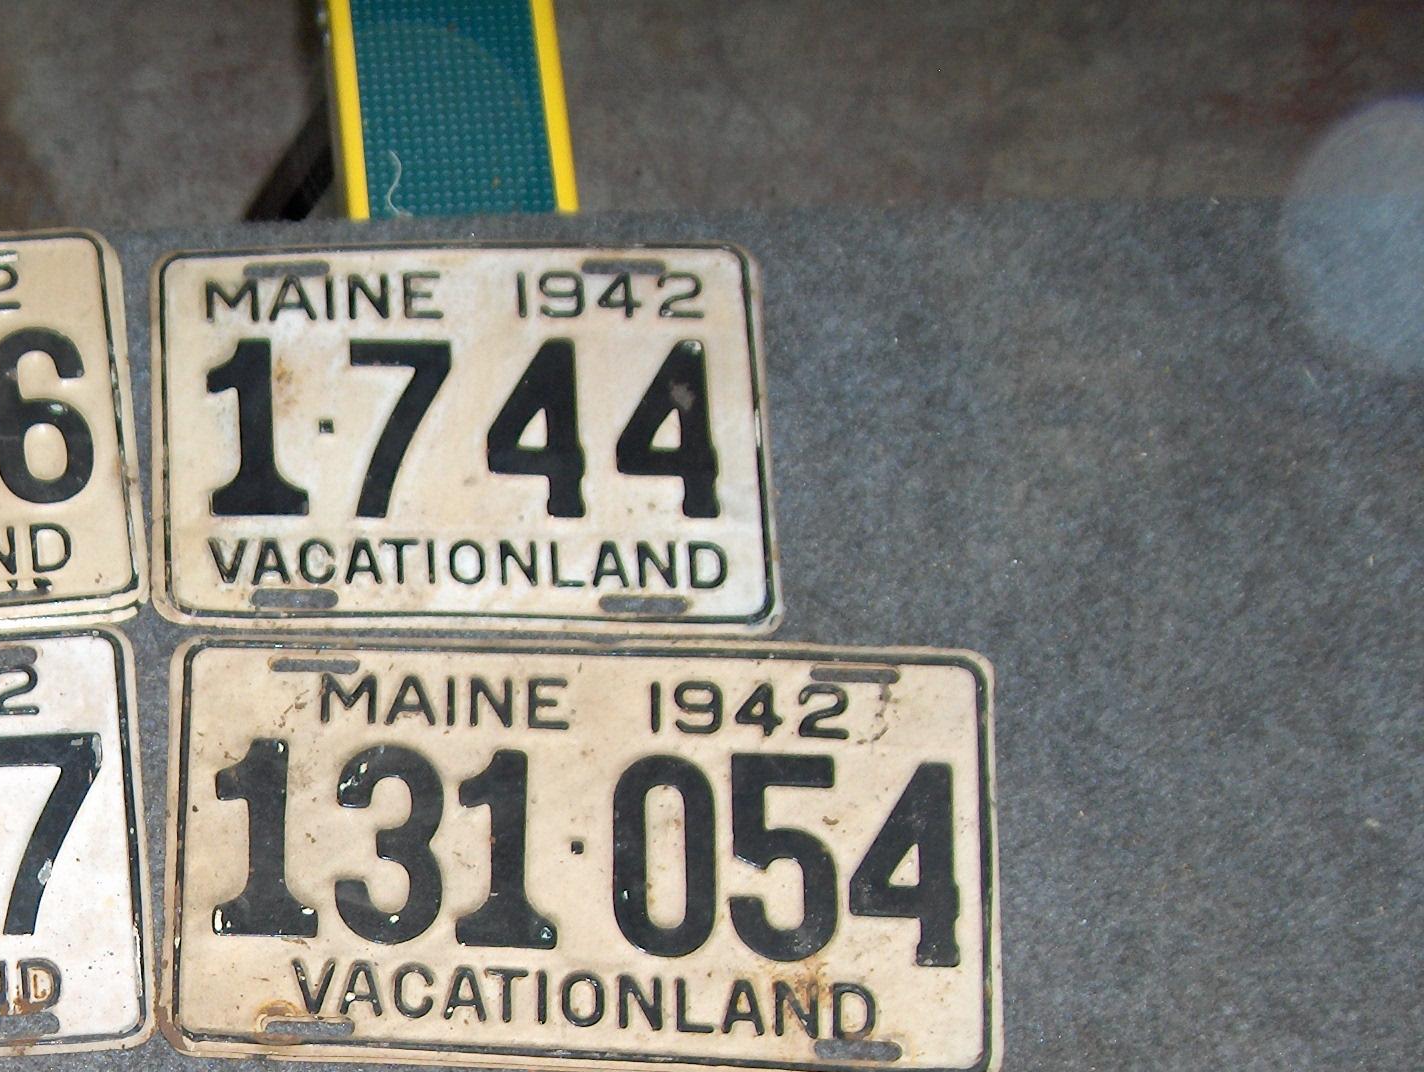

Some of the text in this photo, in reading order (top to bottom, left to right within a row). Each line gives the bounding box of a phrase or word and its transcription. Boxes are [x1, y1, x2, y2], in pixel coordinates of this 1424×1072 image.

[205, 270, 704, 323] MAINE 1942
[207, 538, 728, 589] VACATIONLAND
[320, 672, 850, 740] MAINE 1942
[290, 957, 878, 1042] VACATIONLAND
